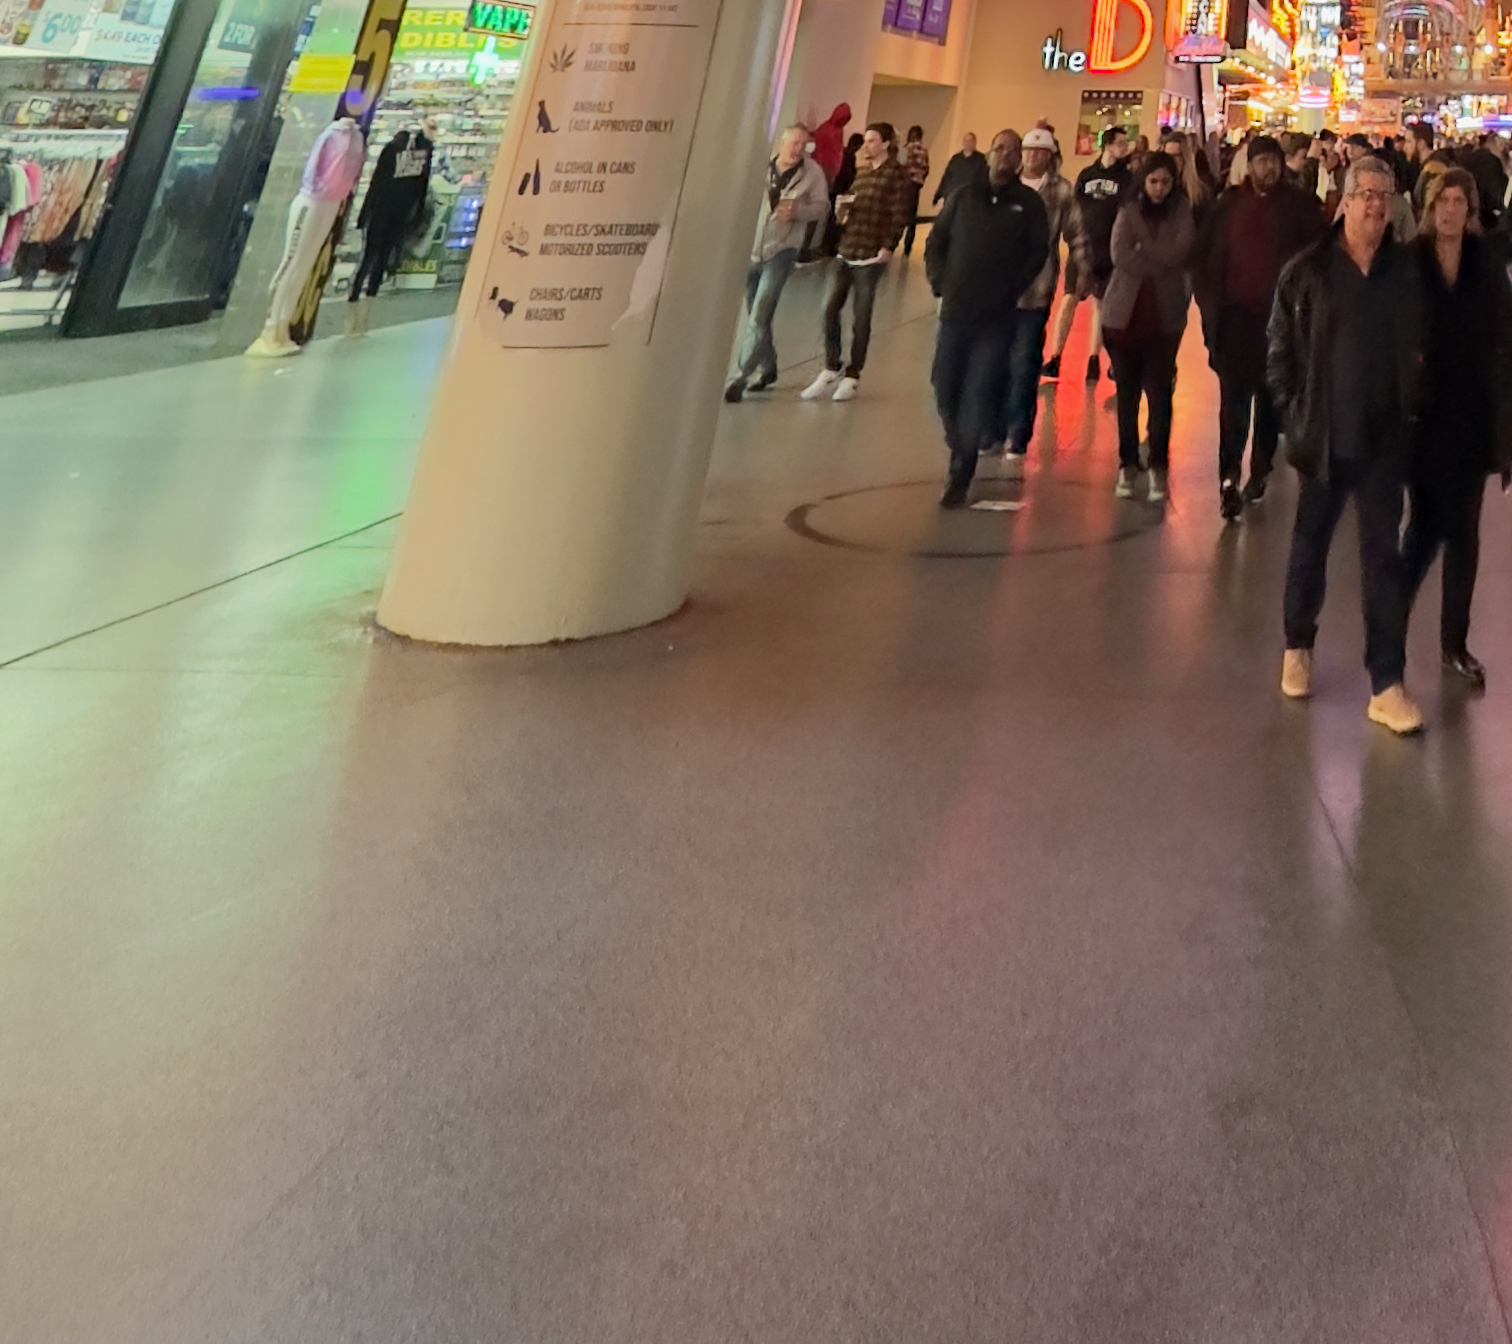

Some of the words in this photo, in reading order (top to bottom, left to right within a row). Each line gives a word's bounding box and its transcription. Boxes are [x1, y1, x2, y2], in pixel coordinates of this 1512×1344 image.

[1042, 27, 1088, 73] the
[592, 118, 643, 133] APPROVED
[554, 161, 594, 175] ALCOHOL
[596, 161, 608, 175] IN
[609, 161, 637, 175] CANS
[562, 179, 606, 193] BOTTLES
[539, 243, 594, 256] MOTORIZED
[529, 287, 603, 301] CHAIRS/CARTS
